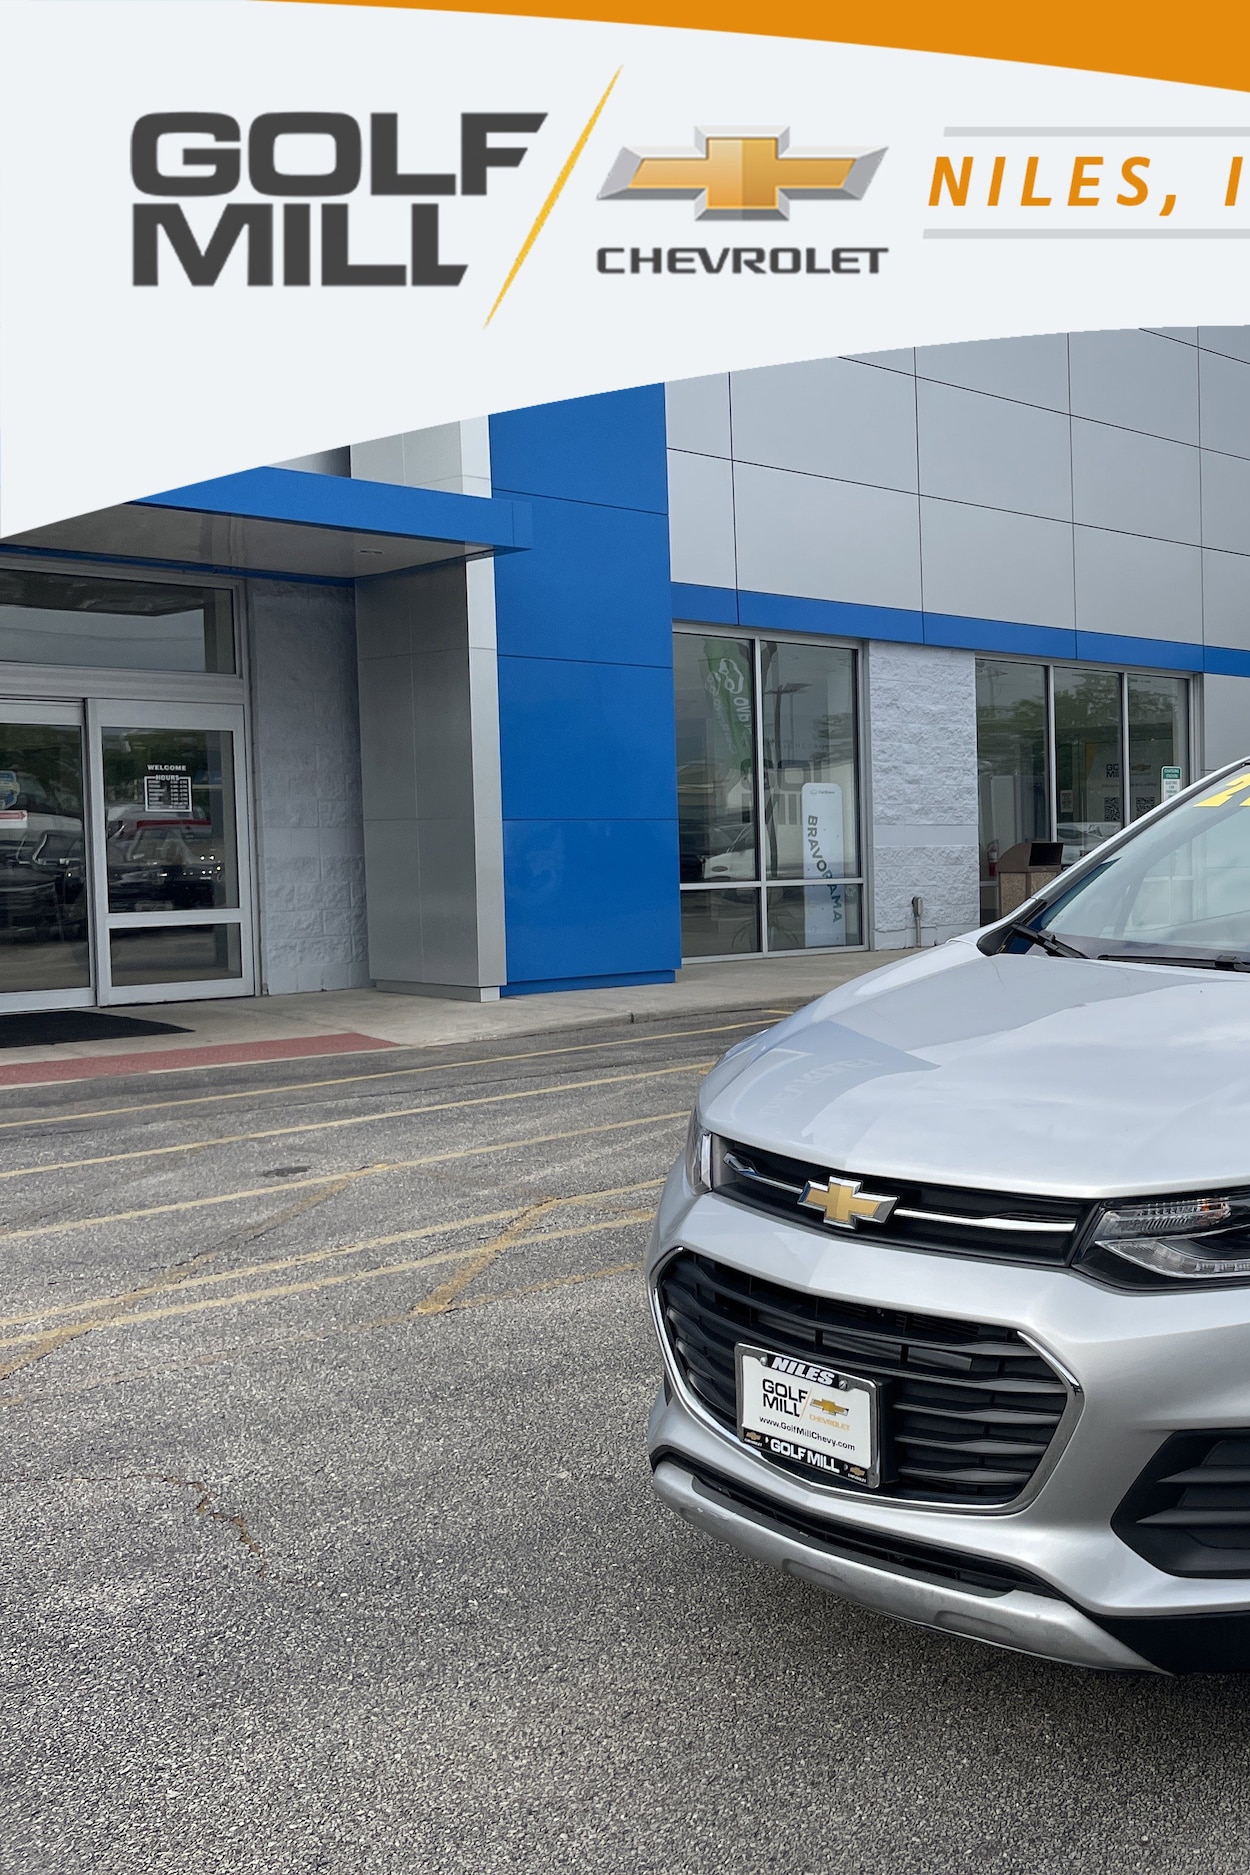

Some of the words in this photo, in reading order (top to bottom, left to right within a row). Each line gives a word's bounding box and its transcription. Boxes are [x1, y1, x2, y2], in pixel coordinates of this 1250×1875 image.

[807, 815, 843, 923] BRAVORAMA
[771, 1357, 835, 1386] NILES
[762, 1378, 809, 1404] GOLF
[763, 1394, 801, 1418] MILL
[759, 1416, 856, 1451] www.GolfMillChevy.com
[809, 1414, 850, 1431] CHEVROLET
[771, 1439, 806, 1461] GOLF
[807, 1450, 840, 1474] MILL
